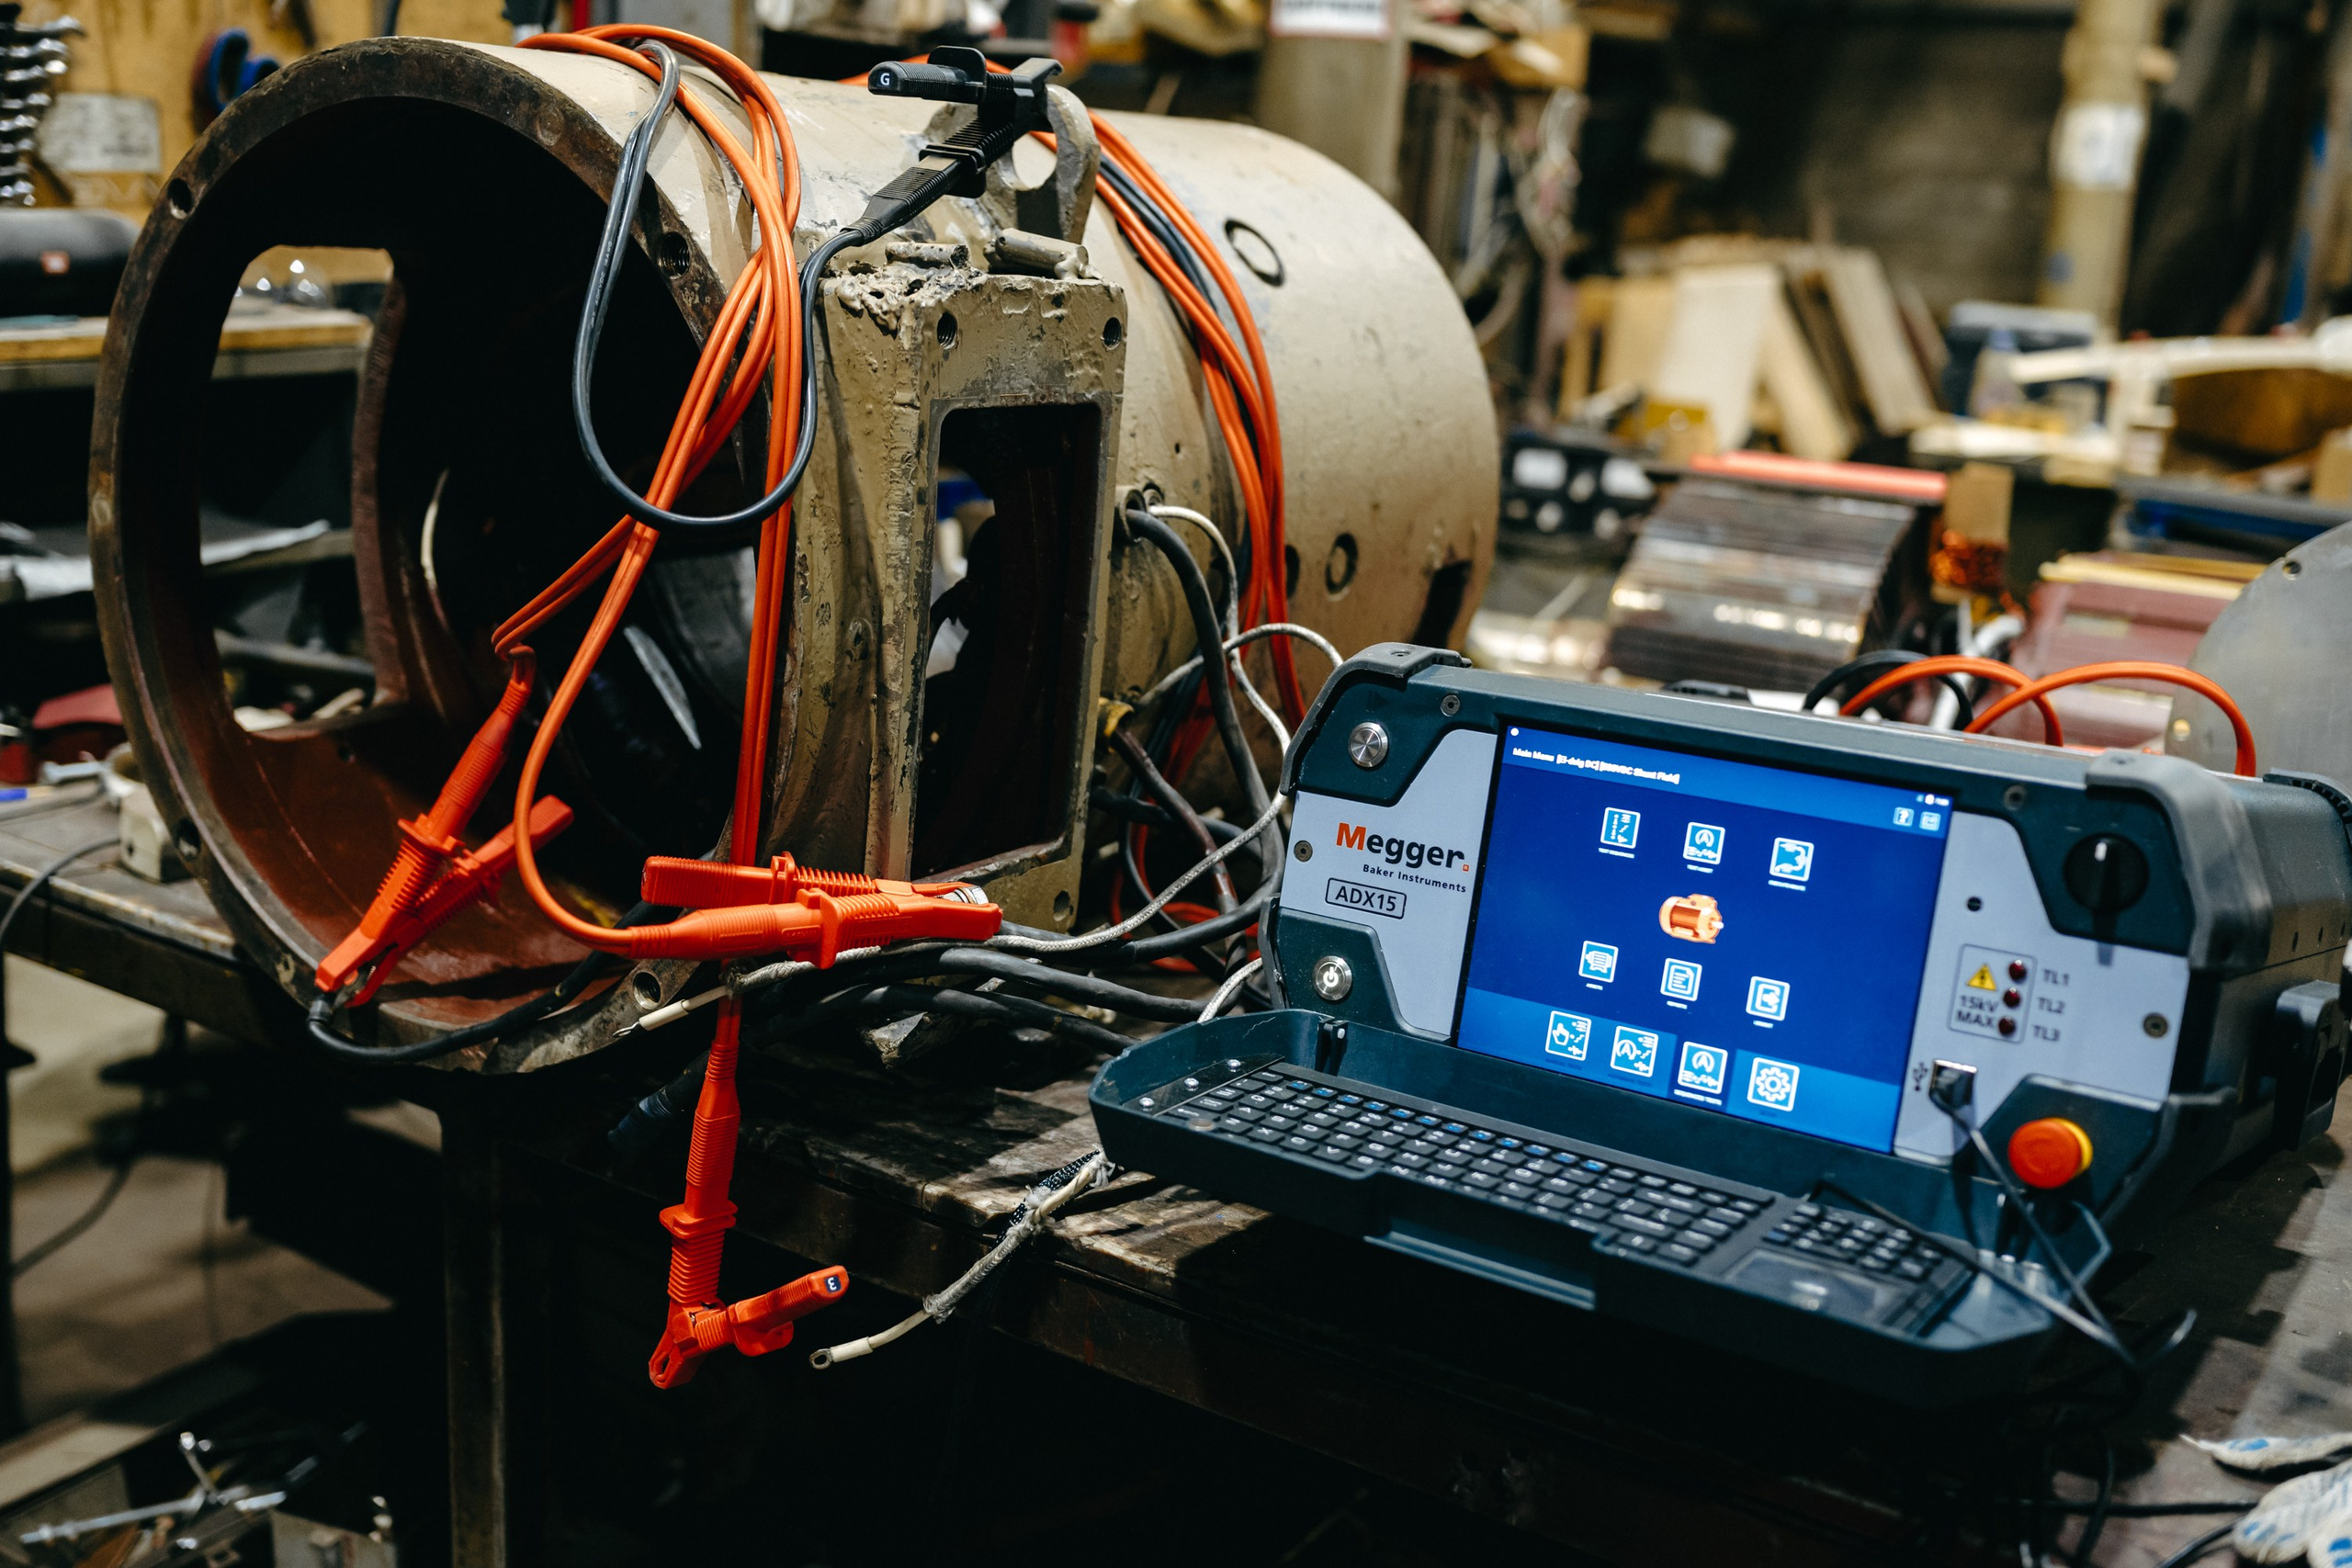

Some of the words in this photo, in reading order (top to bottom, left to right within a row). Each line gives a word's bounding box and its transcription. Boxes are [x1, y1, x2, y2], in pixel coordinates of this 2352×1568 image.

[879, 73, 890, 86] G
[1512, 747, 1532, 758] Main
[1532, 750, 1555, 761] Menu
[1363, 863, 1395, 878] Baker
[1398, 871, 1466, 893] Instruments
[1335, 886, 1397, 912] ADX15
[2042, 968, 2070, 987] TL1
[1960, 994, 1998, 1012] 15kV
[2038, 998, 2065, 1014] TL2
[1955, 1010, 1995, 1029] MAX
[2032, 1024, 2061, 1043] TL3
[827, 1277, 837, 1291] 3
